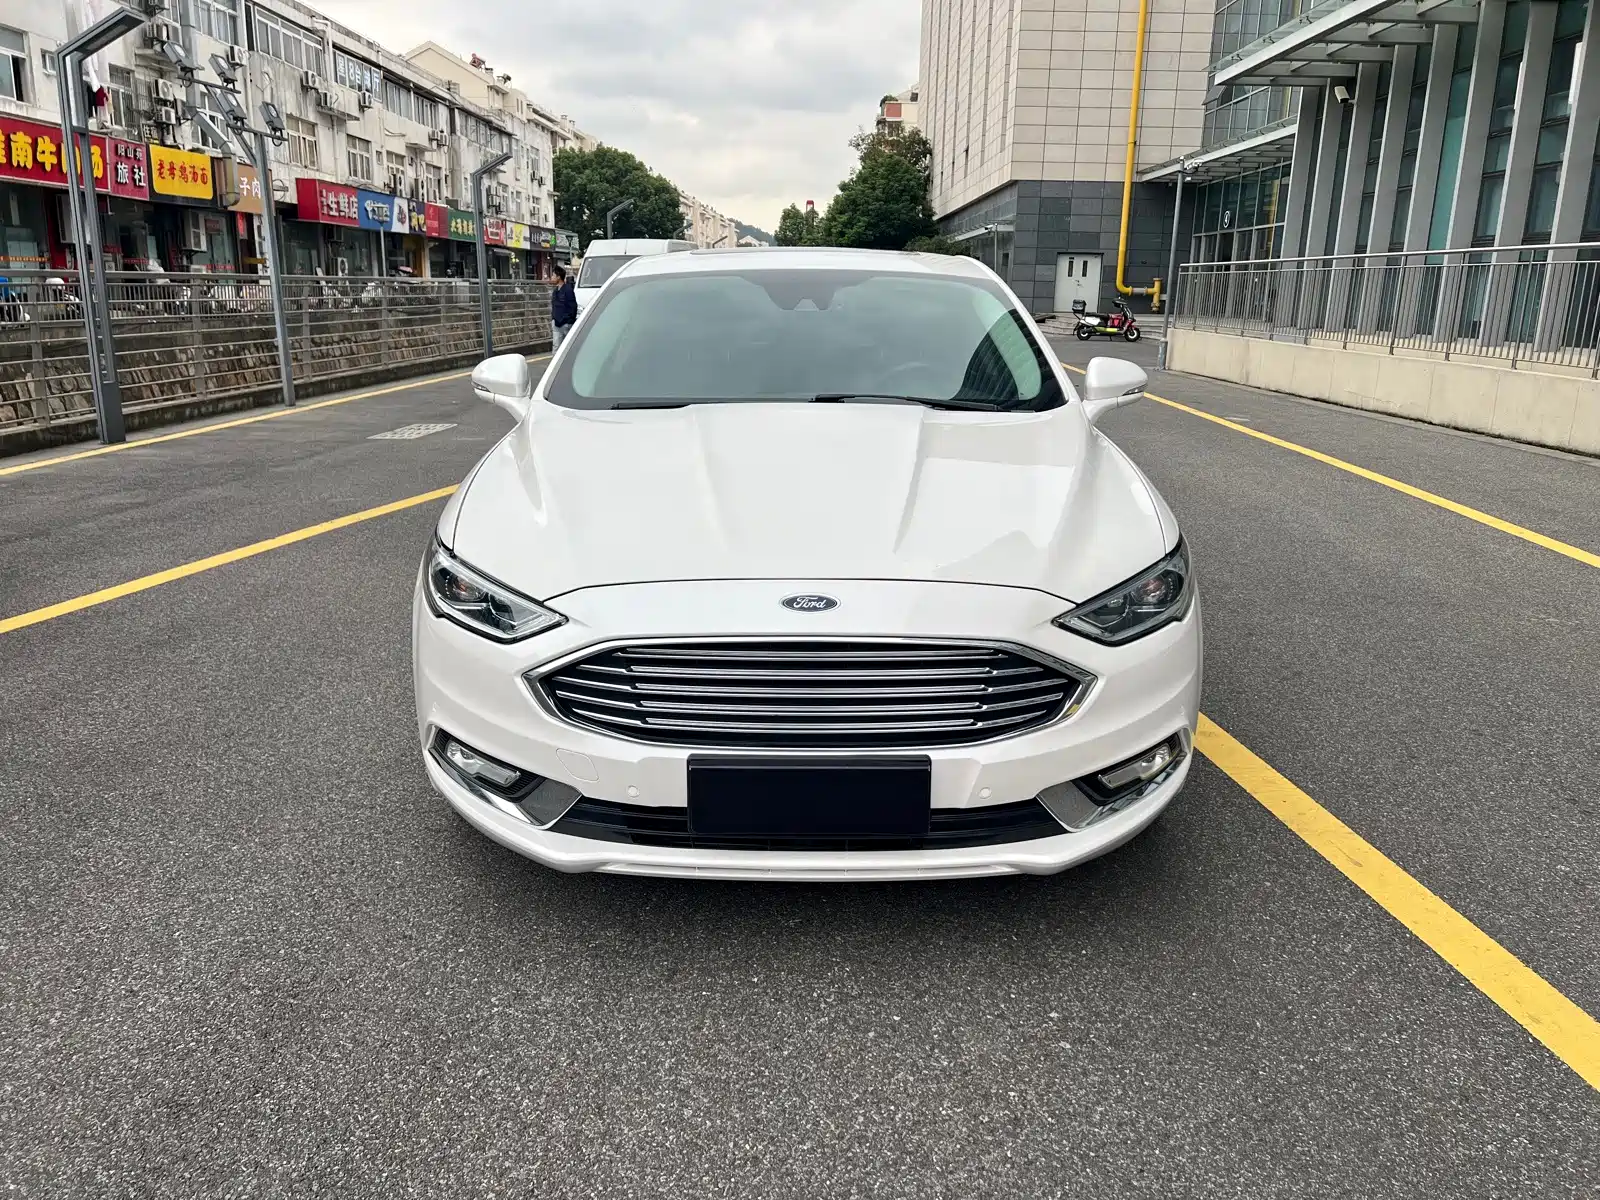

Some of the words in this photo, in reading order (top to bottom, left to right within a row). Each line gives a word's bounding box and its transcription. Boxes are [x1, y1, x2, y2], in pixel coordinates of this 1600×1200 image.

[0, 129, 104, 179] 南牛汤
[117, 161, 146, 187] 旅社
[157, 159, 208, 185] 老母鸡汤面
[327, 191, 359, 219] 生鲜店
[793, 596, 827, 608] Ford
